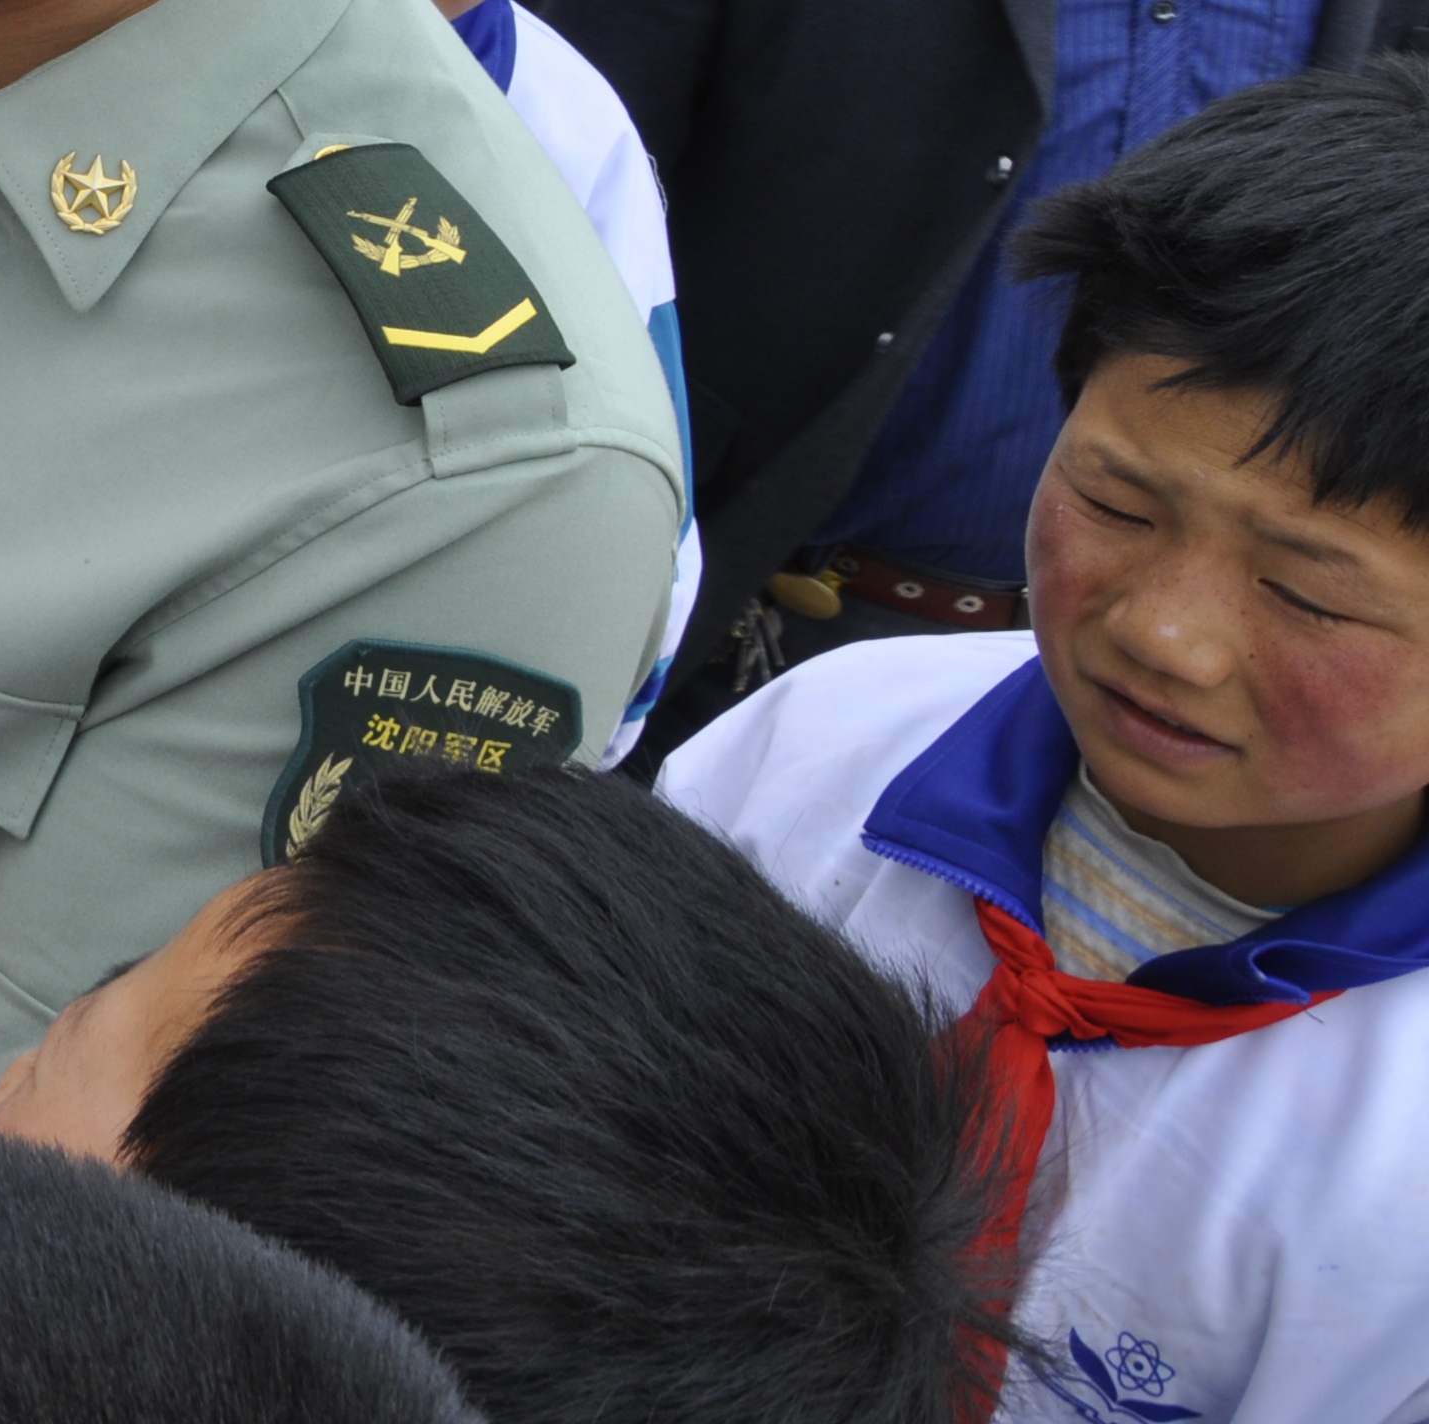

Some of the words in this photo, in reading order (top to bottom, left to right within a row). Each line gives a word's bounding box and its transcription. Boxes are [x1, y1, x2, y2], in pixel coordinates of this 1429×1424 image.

[343, 665, 560, 737] 中国人民解放军
[362, 713, 512, 773] 沈阳军区
